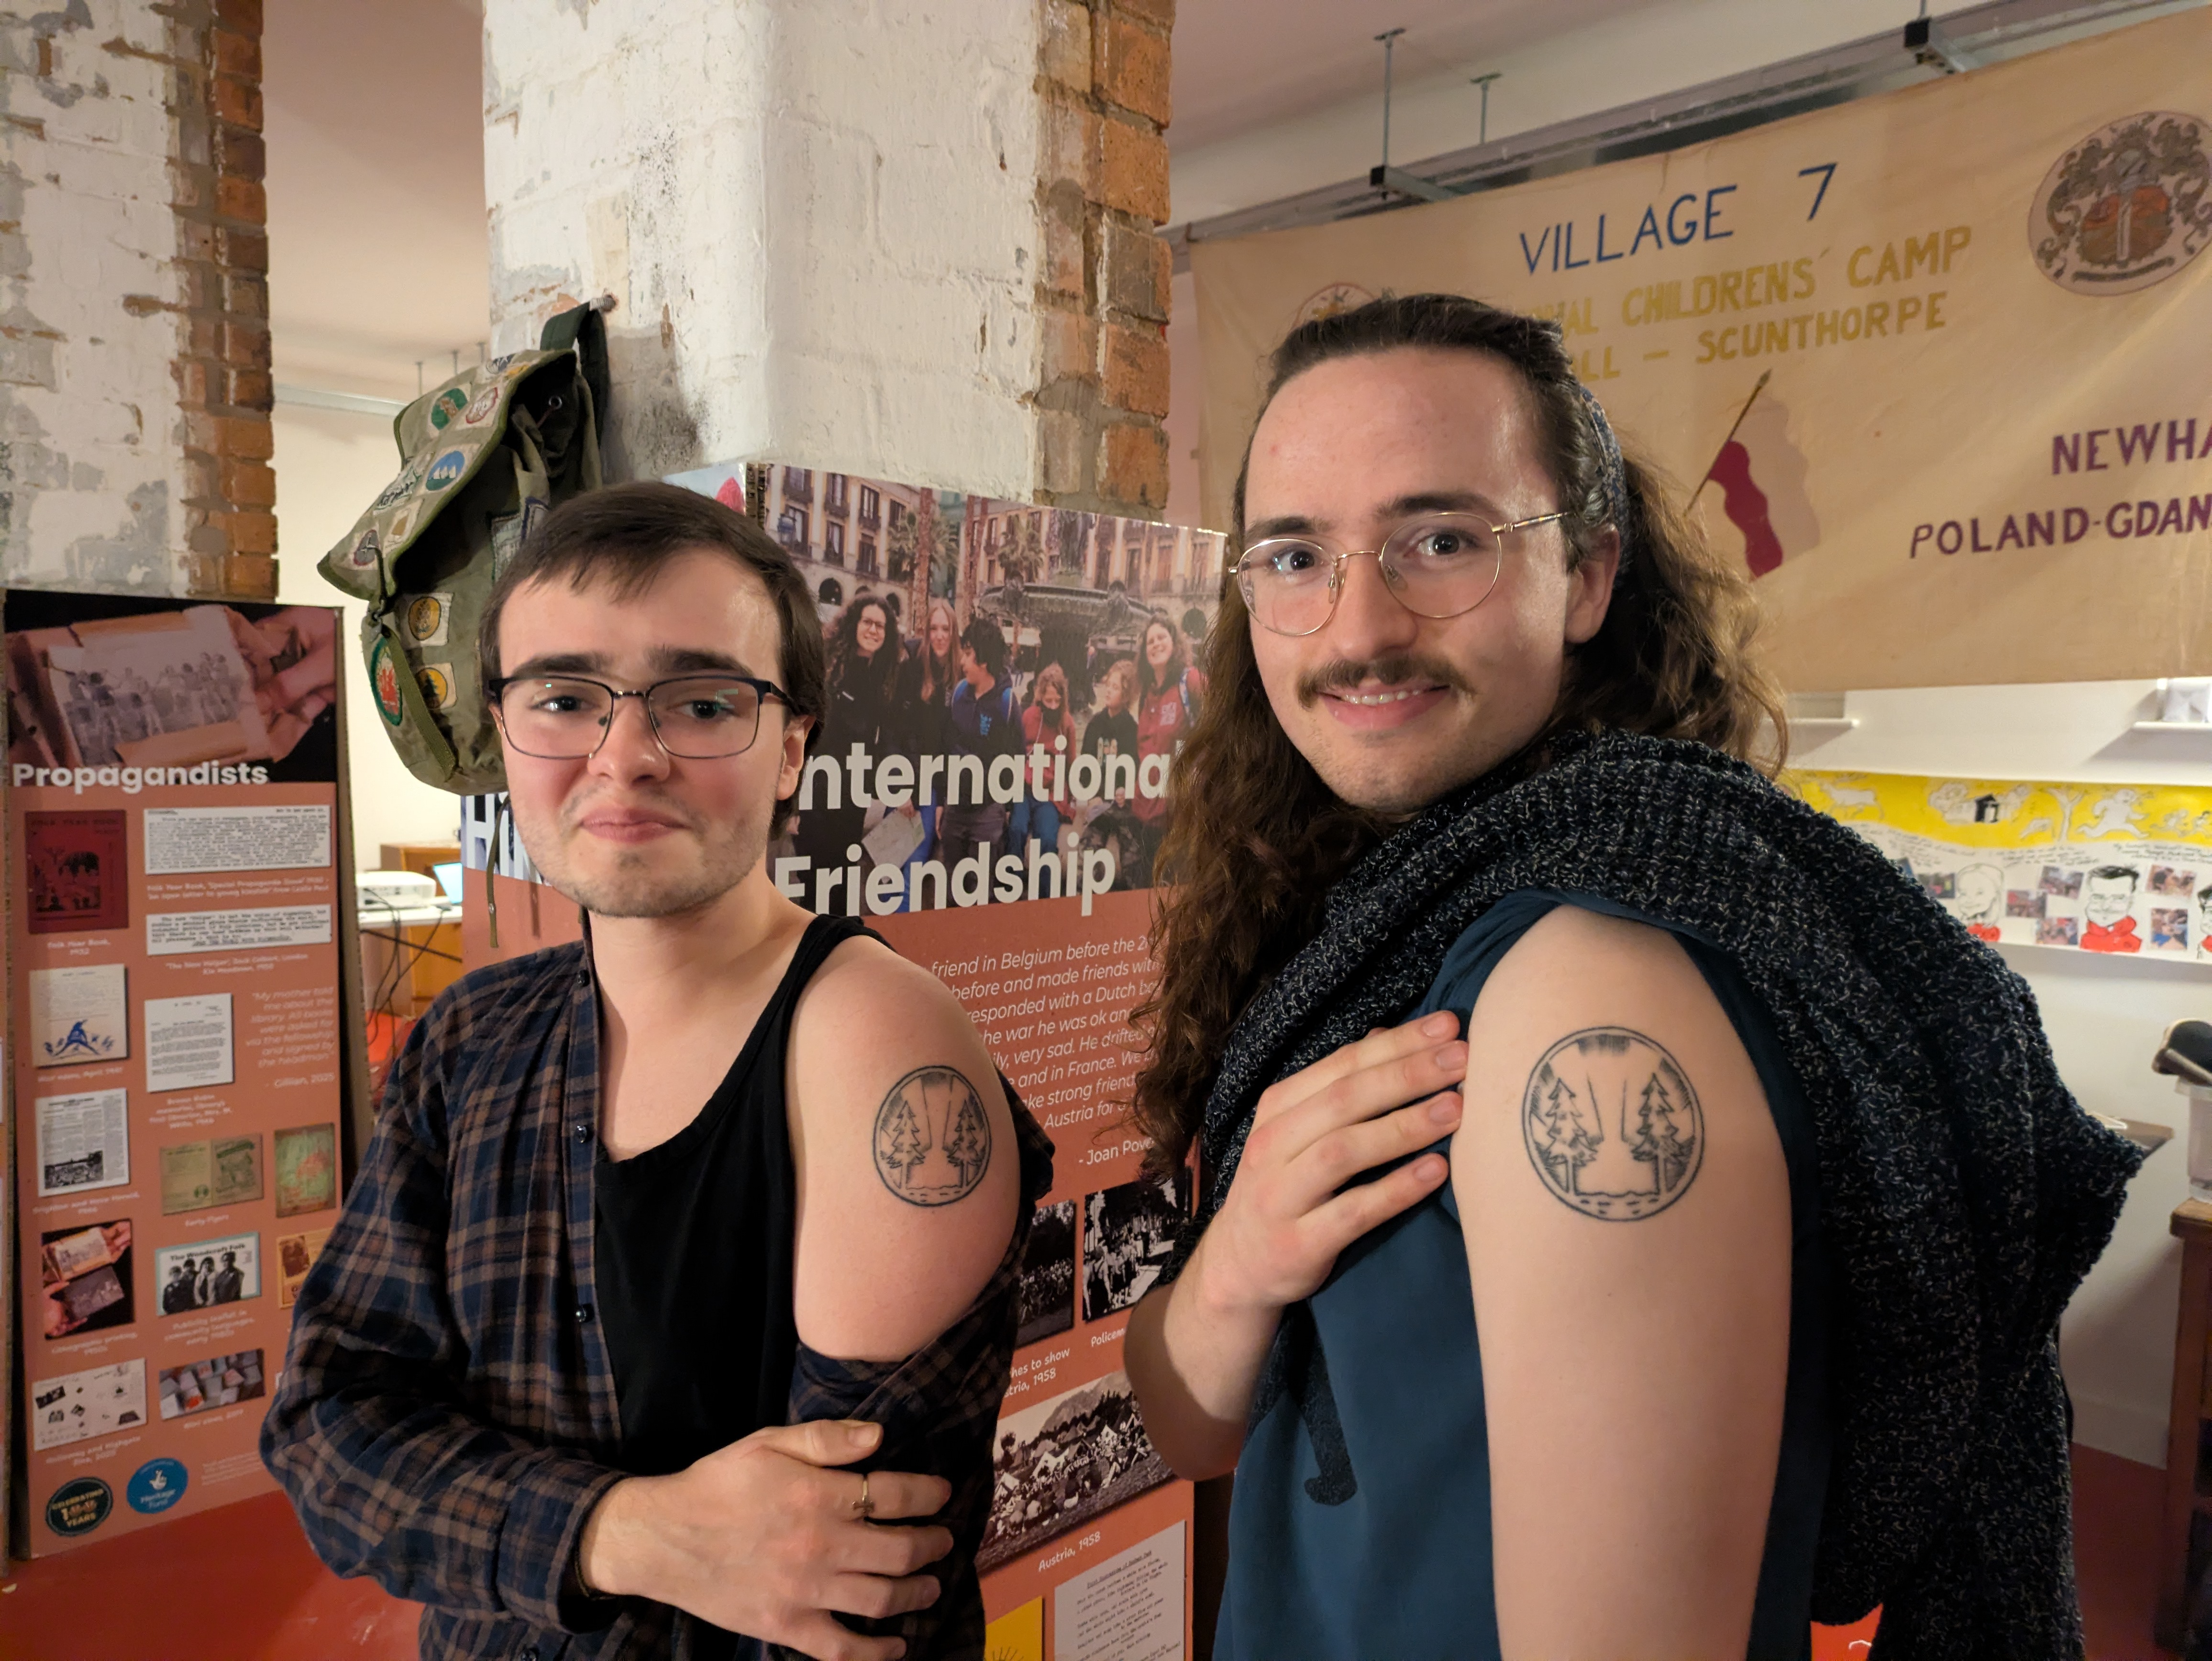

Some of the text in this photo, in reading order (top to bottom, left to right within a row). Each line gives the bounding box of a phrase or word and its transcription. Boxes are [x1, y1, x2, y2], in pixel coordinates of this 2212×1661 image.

[1519, 162, 1838, 276] VILLAGE 7
[1847, 226, 1972, 288] CAMP
[1697, 290, 1948, 365] SCUNTHORPE
[1909, 493, 2212, 559] POLAND-GDAN
[13, 761, 269, 795] Propagandists
[798, 735, 1171, 810] nternationa
[775, 832, 1115, 917] Friendship
[932, 956, 979, 978] friend
[982, 955, 996, 972] in
[1001, 949, 1062, 971] Belgium
[1066, 941, 1110, 961] before
[1113, 937, 1135, 954] the
[952, 981, 1000, 1000] before
[1003, 973, 1033, 994] and
[1037, 966, 1080, 988] made
[1083, 960, 1129, 982] friends
[1049, 990, 1079, 1010] with
[1083, 991, 1092, 1004] a
[1095, 981, 1136, 1003] Dutch
[1006, 1025, 1035, 1042] war
[1037, 1019, 1056, 1036] he
[1059, 1016, 1087, 1032] was
[1090, 1009, 1106, 1025] ok
[1014, 1047, 1045, 1065] very
[1046, 1037, 1075, 1058] sad.
[1079, 1034, 1099, 1052] He
[1018, 1066, 1049, 1088] and
[1051, 1064, 1063, 1081] in
[1067, 1056, 1117, 1078] France.
[1047, 1084, 1092, 1106] strong
[1095, 1071, 1137, 1095] friend
[1044, 1105, 1094, 1129] Austria
[1086, 1146, 1119, 1165] Joan
[1031, 1359, 1042, 1371] to
[1044, 1347, 1071, 1365] show
[1033, 1367, 1057, 1386] 1958
[1038, 1544, 1076, 1572] Austria,
[1078, 1531, 1101, 1551] 1958
